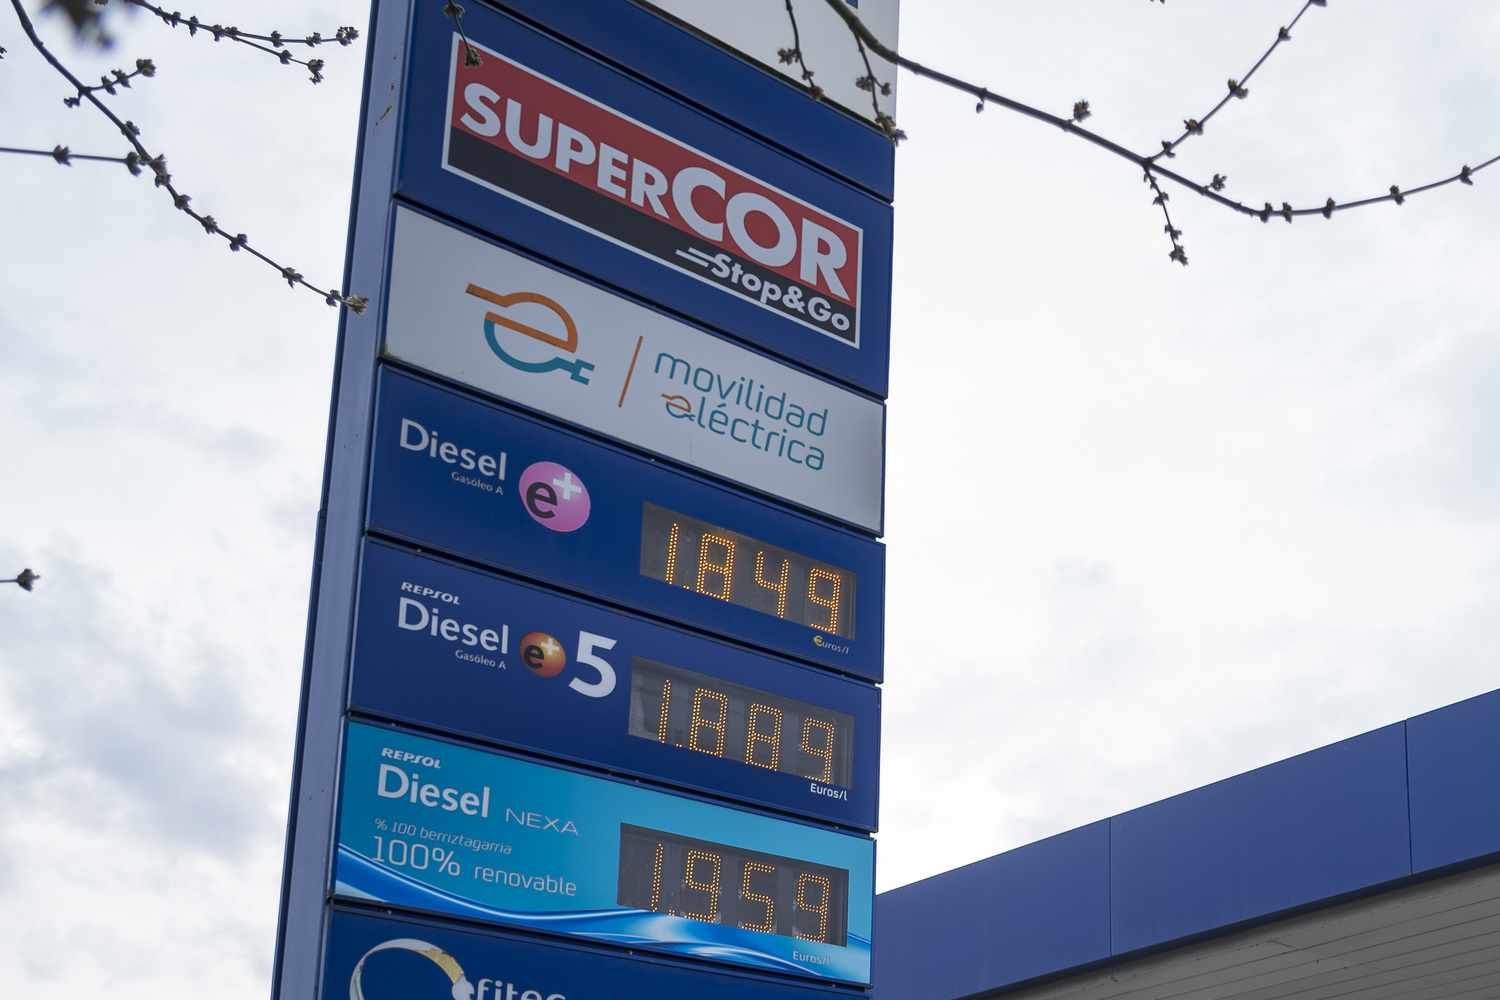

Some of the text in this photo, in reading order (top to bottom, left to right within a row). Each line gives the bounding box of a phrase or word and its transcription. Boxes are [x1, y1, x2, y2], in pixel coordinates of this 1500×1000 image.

[459, 82, 851, 301] SUPERCOR
[708, 252, 850, 331] Stop&Go
[655, 351, 827, 437] movilidad
[400, 418, 507, 480] Diesel
[661, 392, 825, 471] eléctrica
[451, 470, 504, 495] Gasóleo A
[401, 582, 461, 606] REPSOL
[664, 523, 842, 636] 1.849
[398, 597, 509, 655] Diesel
[568, 630, 618, 698] 5
[455, 649, 507, 669] Gasóleo A
[381, 747, 441, 769] REPSOL
[657, 680, 836, 784] 1.889
[377, 763, 580, 836] Diesel NEXA
[809, 782, 848, 801] Euros/l
[371, 834, 578, 898] 100% renovable
[374, 818, 513, 856] % 100 berriztagarria
[650, 842, 831, 943] 1.959
[791, 949, 832, 967] Euros/l
